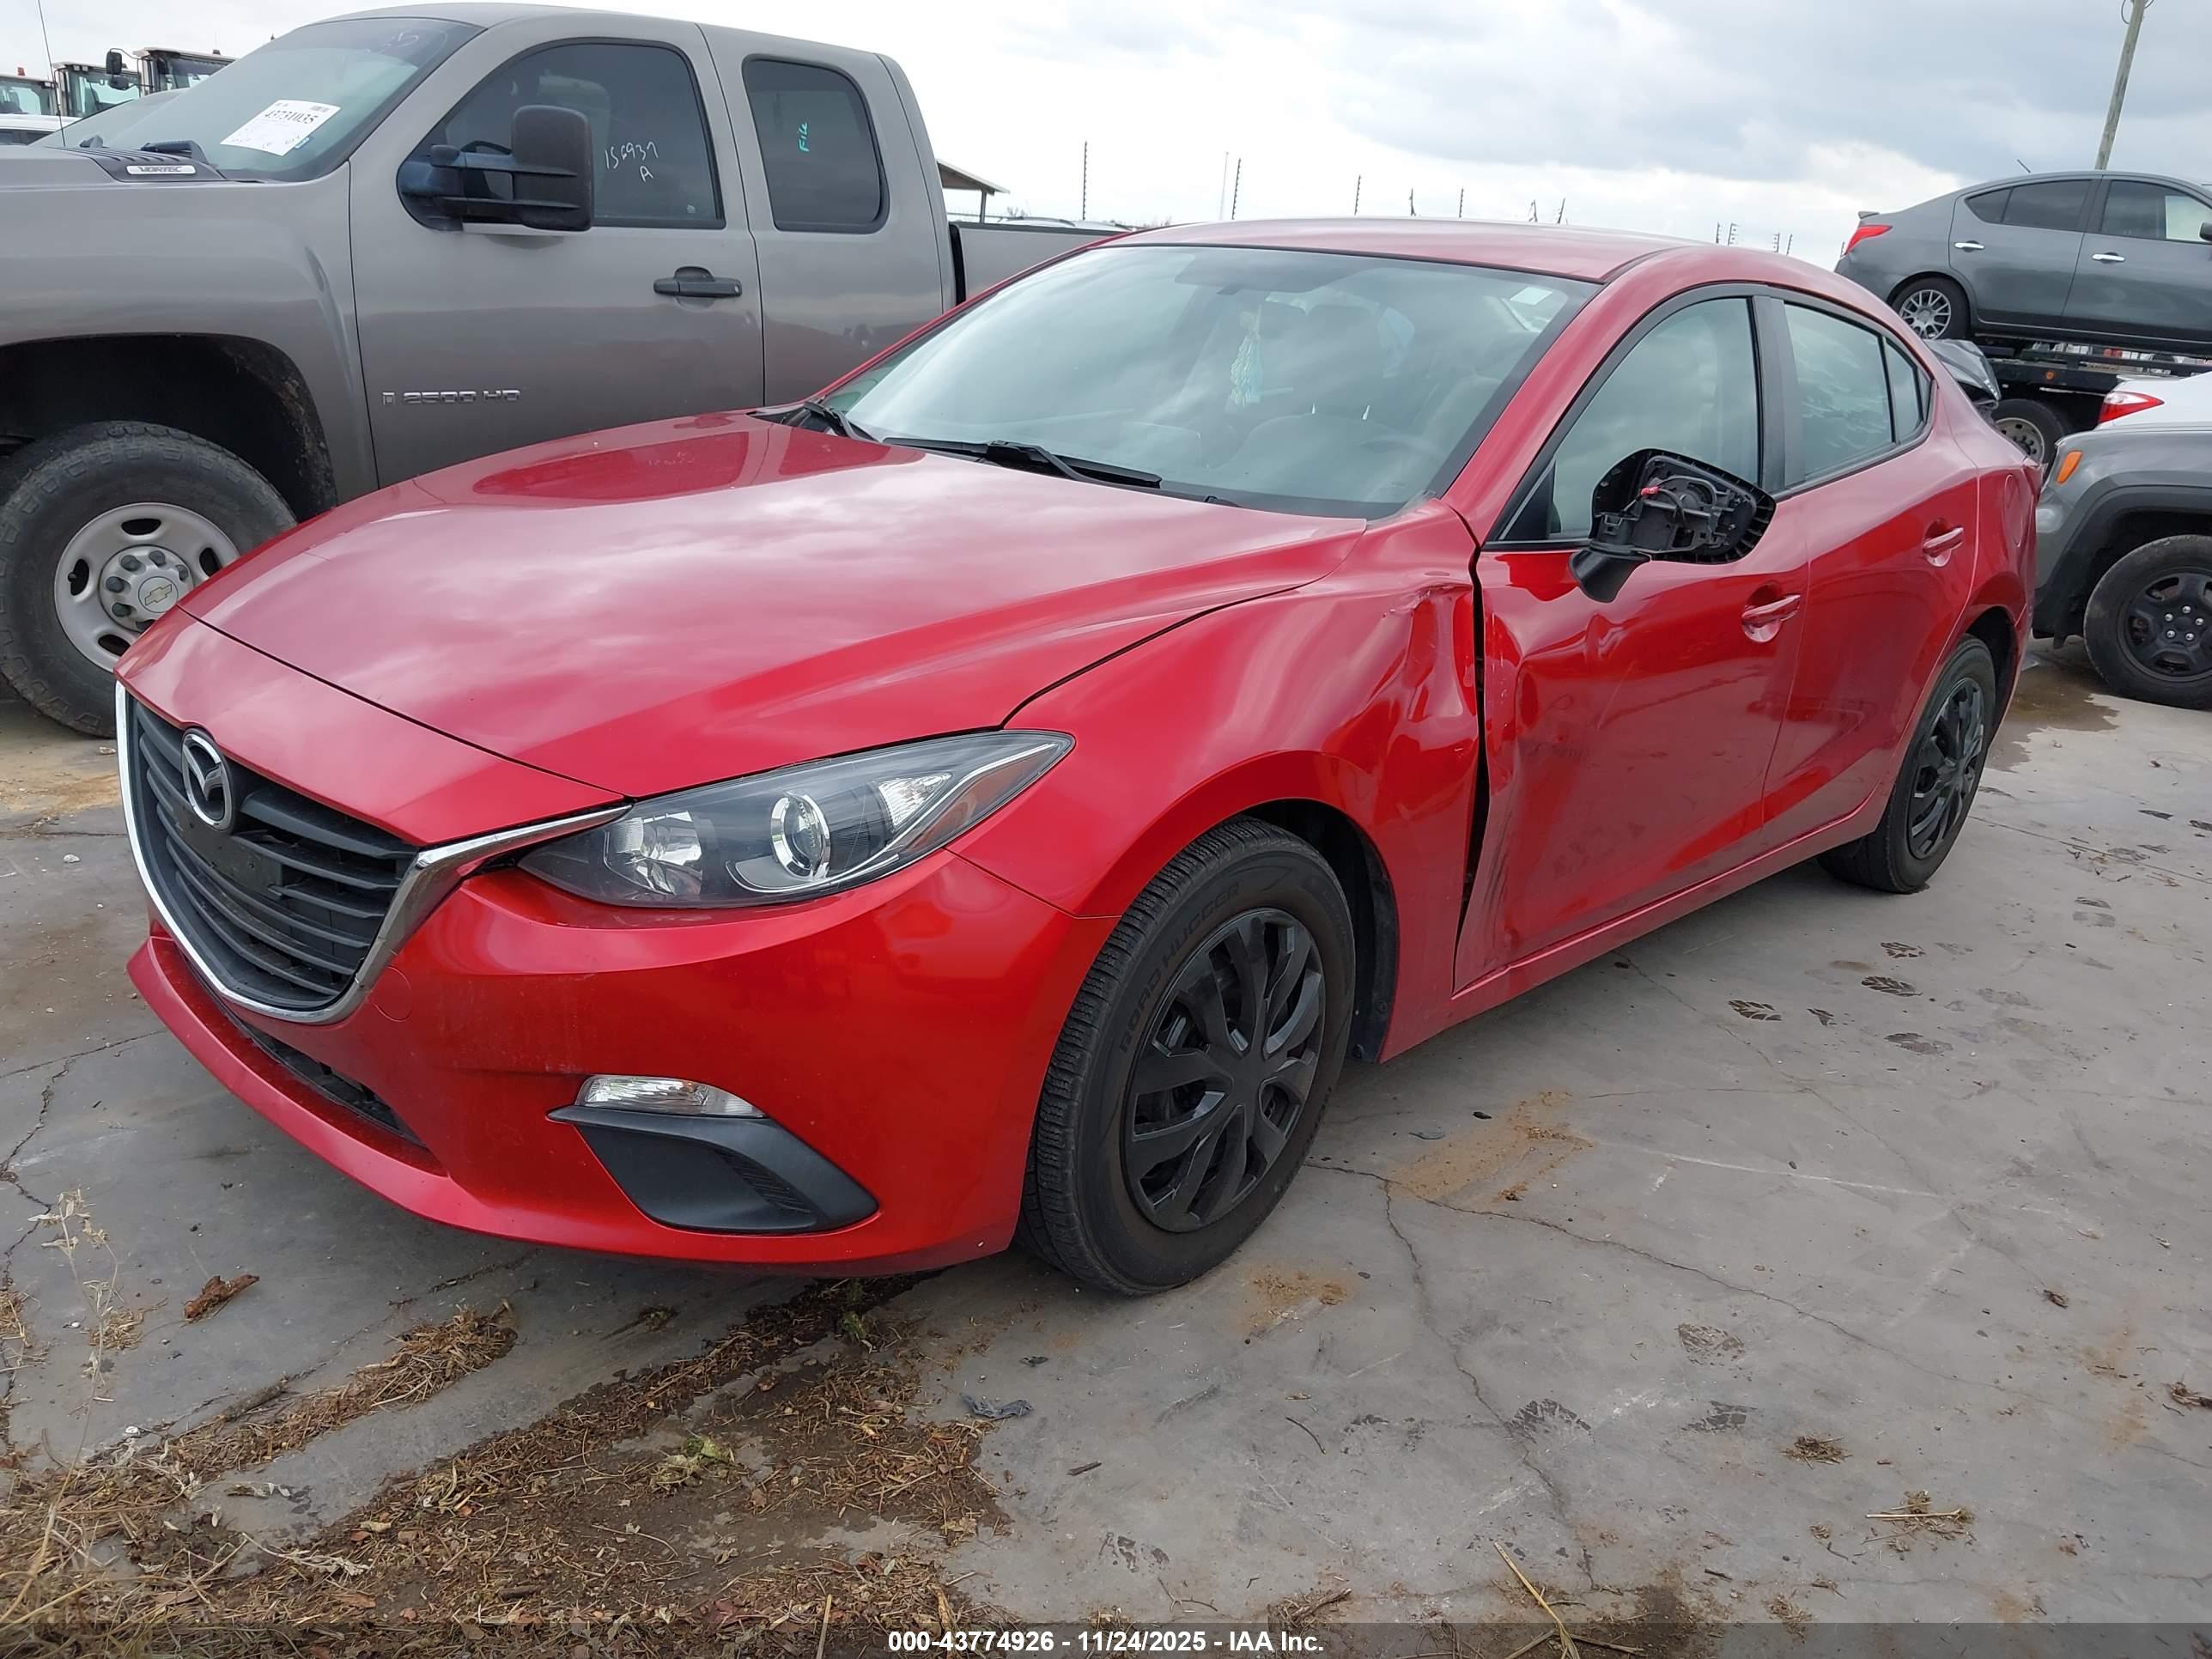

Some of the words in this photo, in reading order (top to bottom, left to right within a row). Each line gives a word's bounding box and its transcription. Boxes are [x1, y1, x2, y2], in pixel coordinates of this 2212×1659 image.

[639, 165, 653, 182] A
[404, 392, 477, 404] 2500
[483, 390, 521, 402] HD
[1120, 967, 1163, 1054] ROAD
